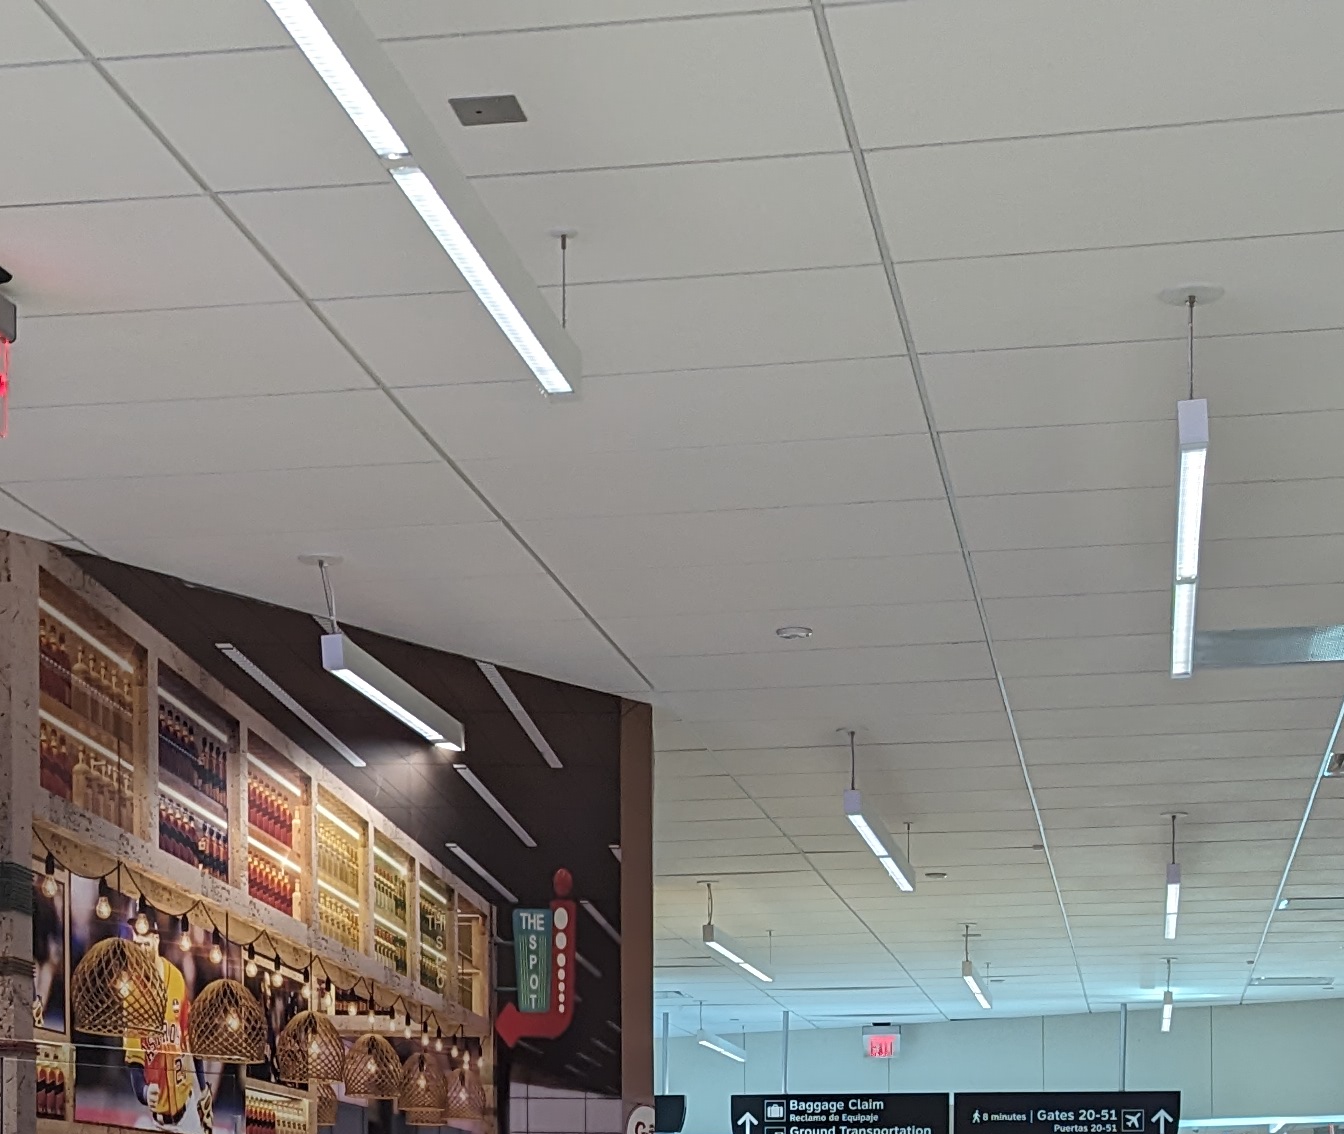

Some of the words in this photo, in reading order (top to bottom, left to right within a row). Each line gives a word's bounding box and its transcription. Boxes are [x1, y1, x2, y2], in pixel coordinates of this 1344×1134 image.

[519, 912, 545, 931] THE
[789, 1100, 845, 1113] Baggage
[848, 1099, 884, 1110] Claim
[789, 1113, 827, 1122] Reclamo
[828, 1113, 840, 1122] de
[841, 1113, 879, 1124] Equipaje
[982, 1113, 989, 1121] 8
[990, 1112, 1027, 1121] minutes
[1037, 1109, 1075, 1121] Gates
[1078, 1109, 1118, 1121] 20-51
[1053, 1124, 1089, 1133] Puertas
[1090, 1124, 1118, 1133] 20-51
